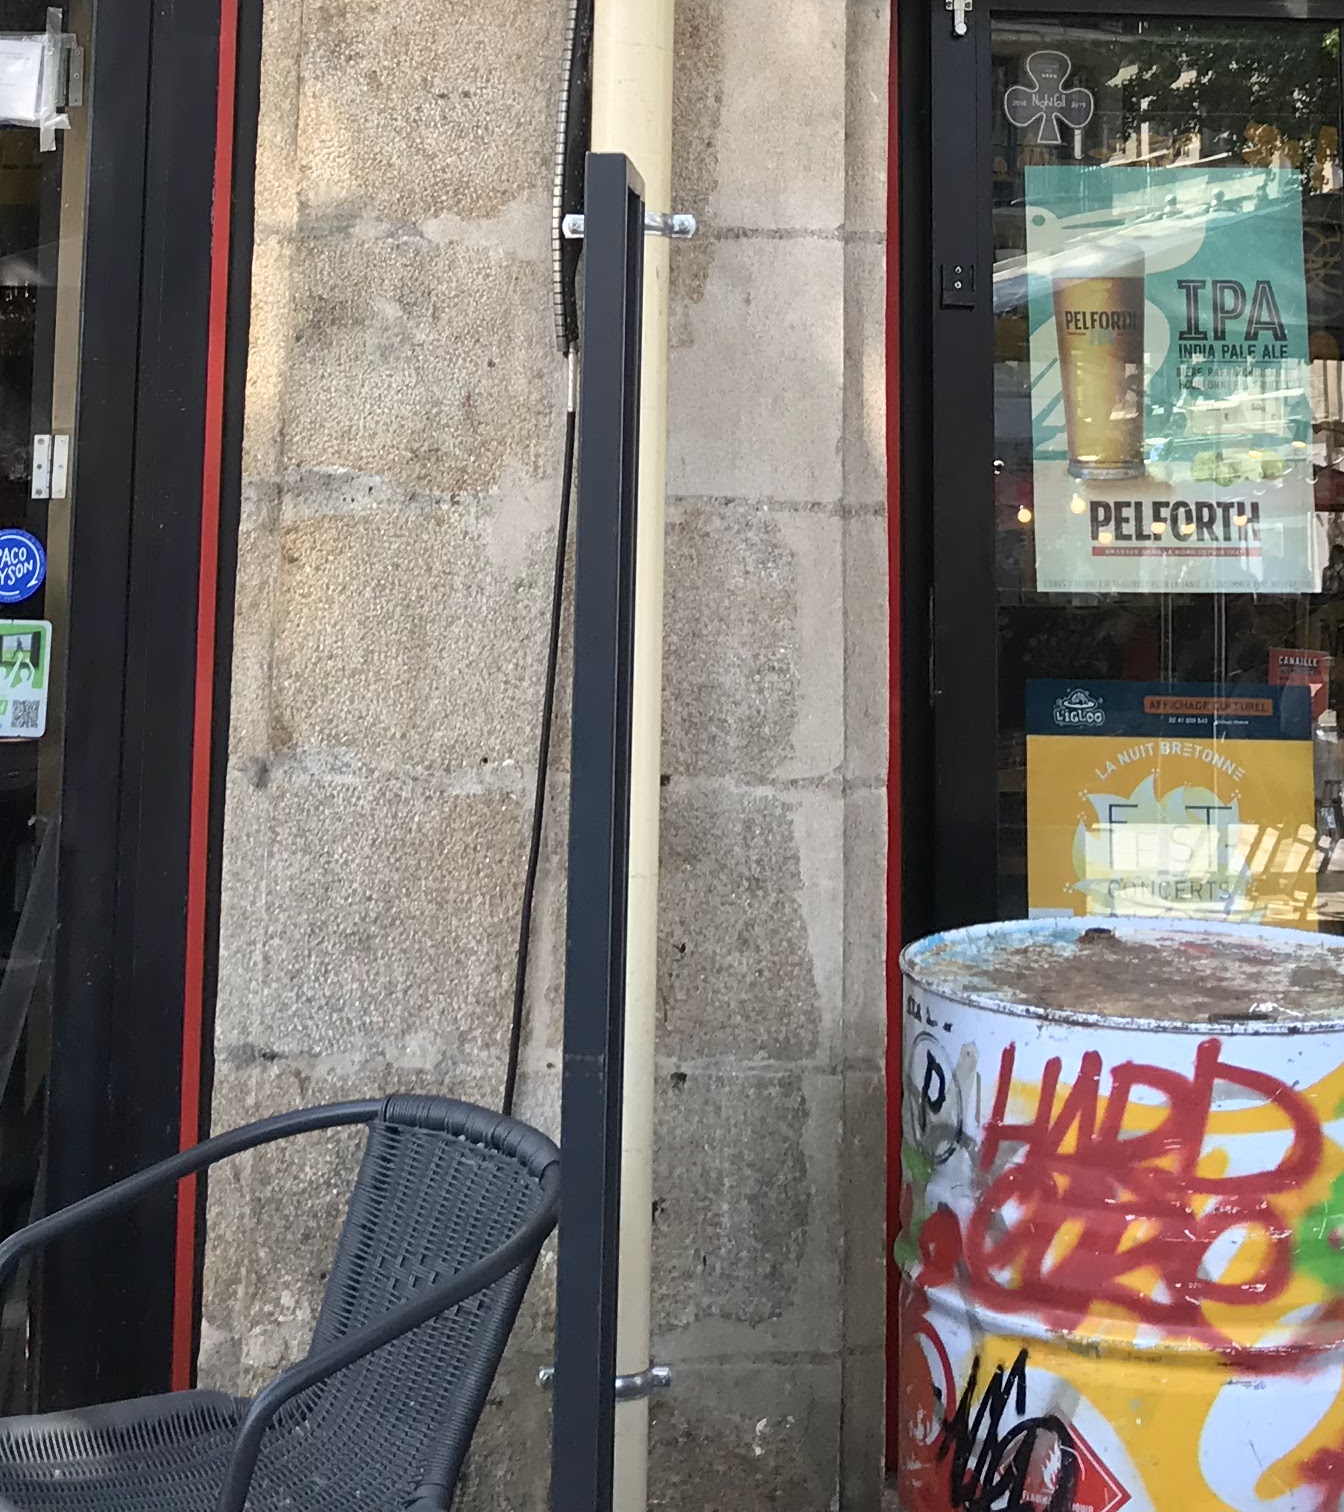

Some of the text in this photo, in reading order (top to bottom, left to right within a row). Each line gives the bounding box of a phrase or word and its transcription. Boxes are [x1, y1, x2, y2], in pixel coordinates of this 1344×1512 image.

[1064, 310, 1137, 331] PELFORTH
[1177, 279, 1288, 341] IPA
[1178, 344, 1288, 360] INDIA PALE ALE
[1089, 500, 1262, 542] PELFORTH
[1278, 655, 1319, 667] CANAILLE
[1095, 741, 1246, 782] LA NUIT BRETONNE
[1107, 879, 1232, 901] CONCERTS
